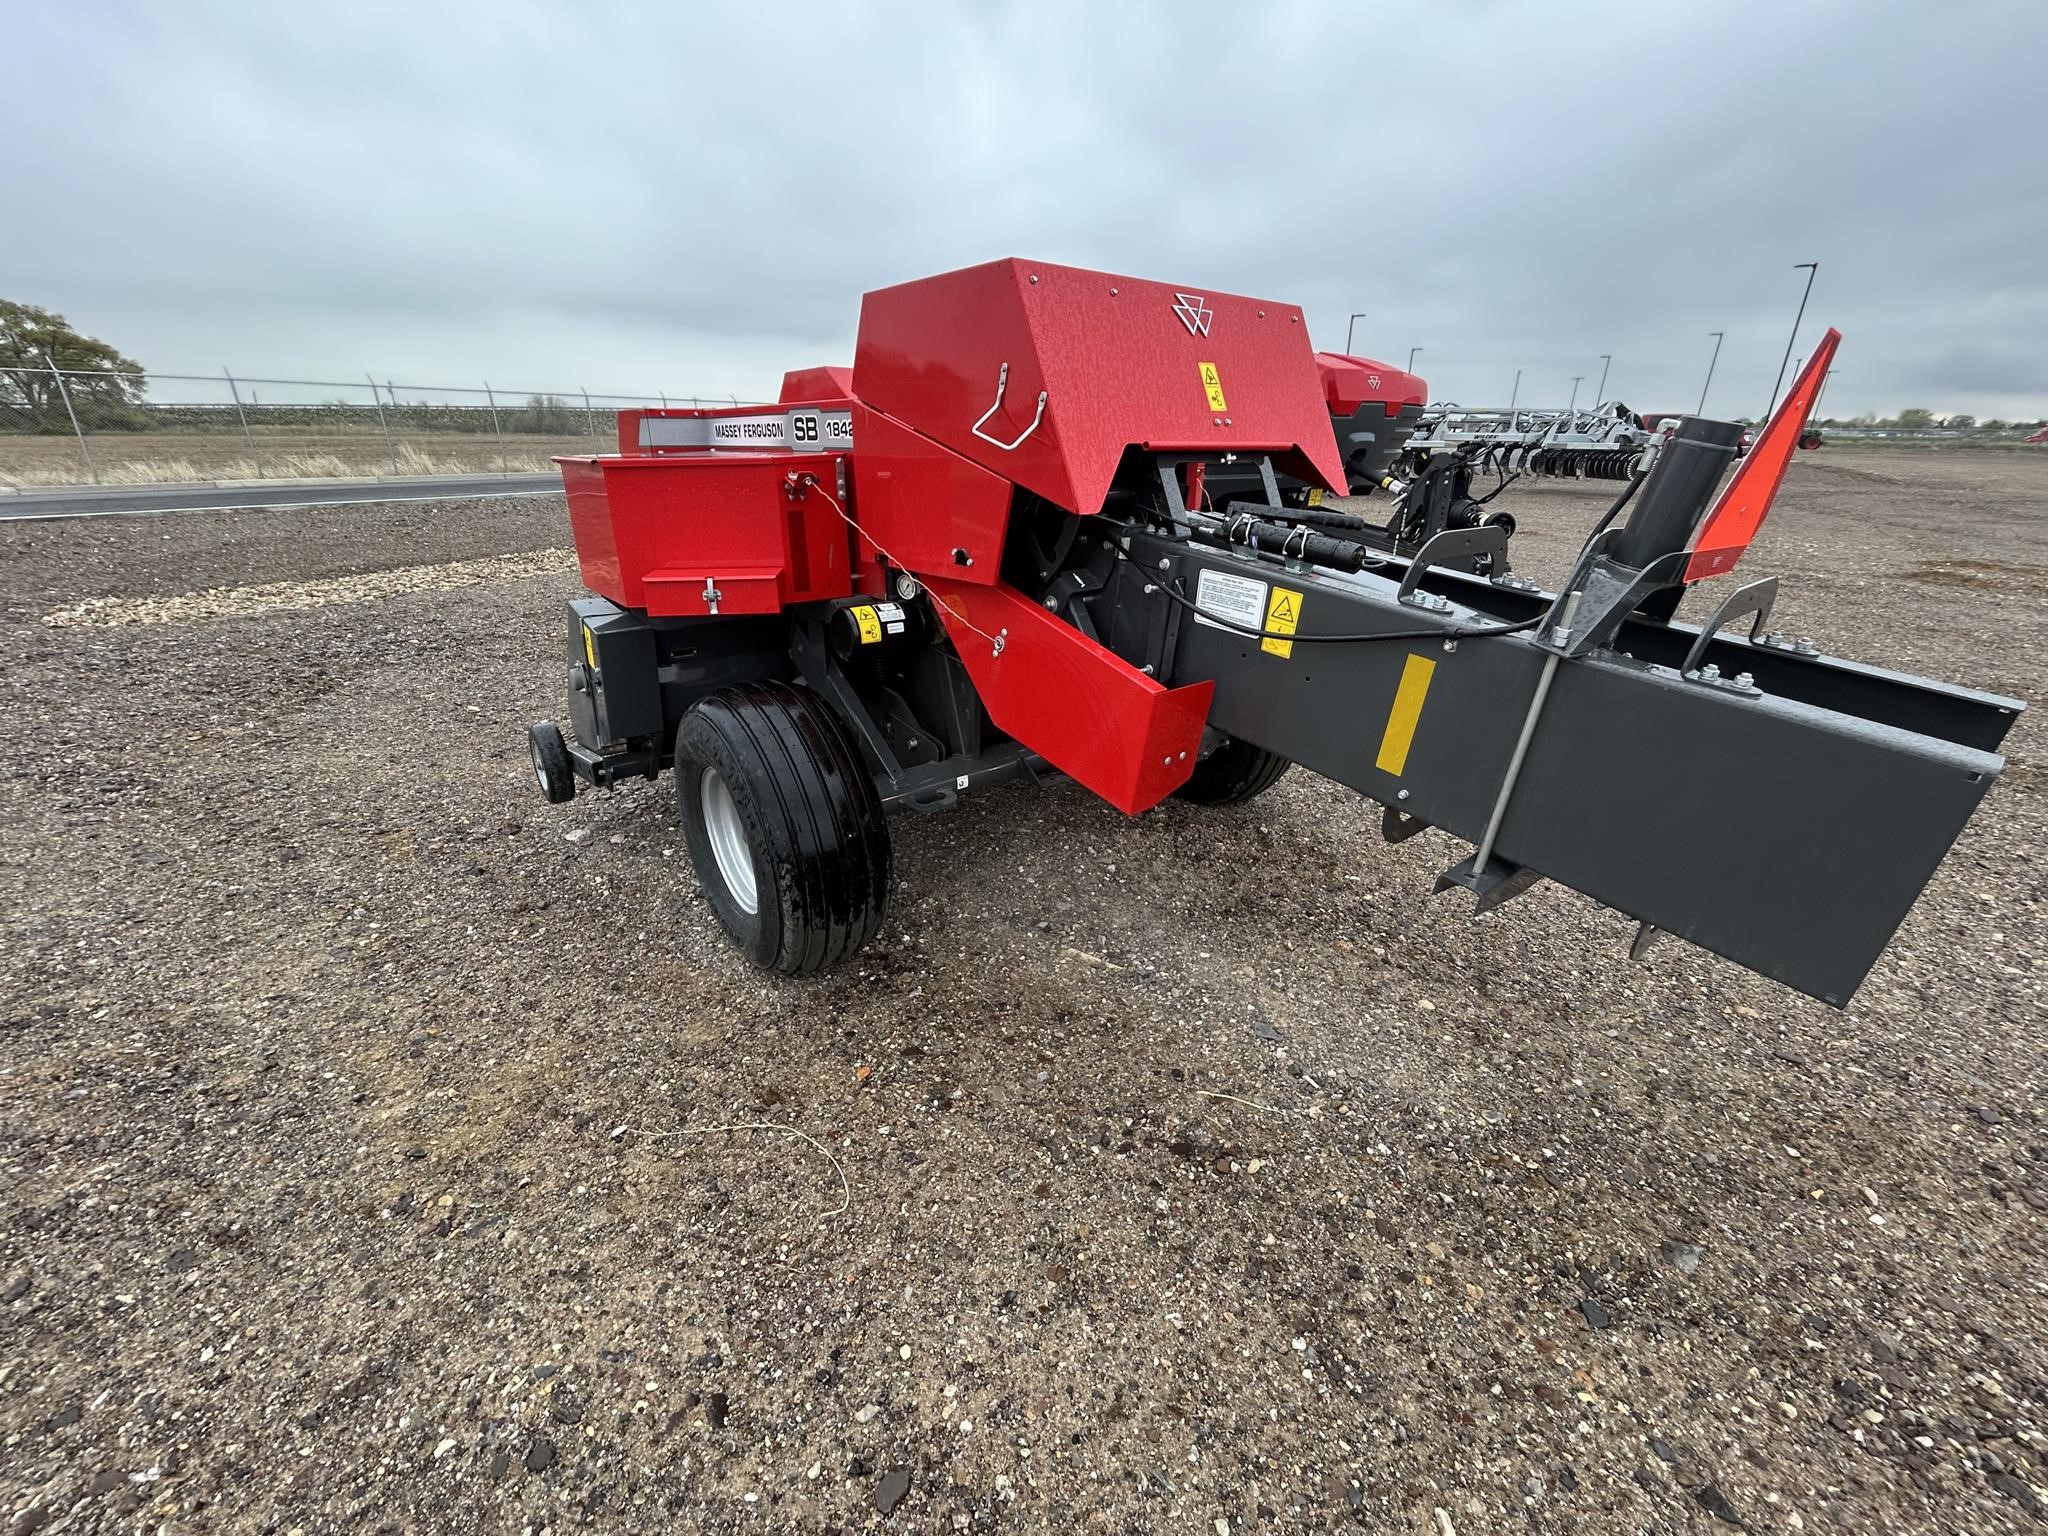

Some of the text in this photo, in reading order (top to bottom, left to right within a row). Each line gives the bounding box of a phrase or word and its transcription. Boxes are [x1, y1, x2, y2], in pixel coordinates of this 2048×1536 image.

[714, 424, 742, 438] MASSEY
[743, 422, 784, 438] FERGUSON
[794, 416, 818, 441] SB
